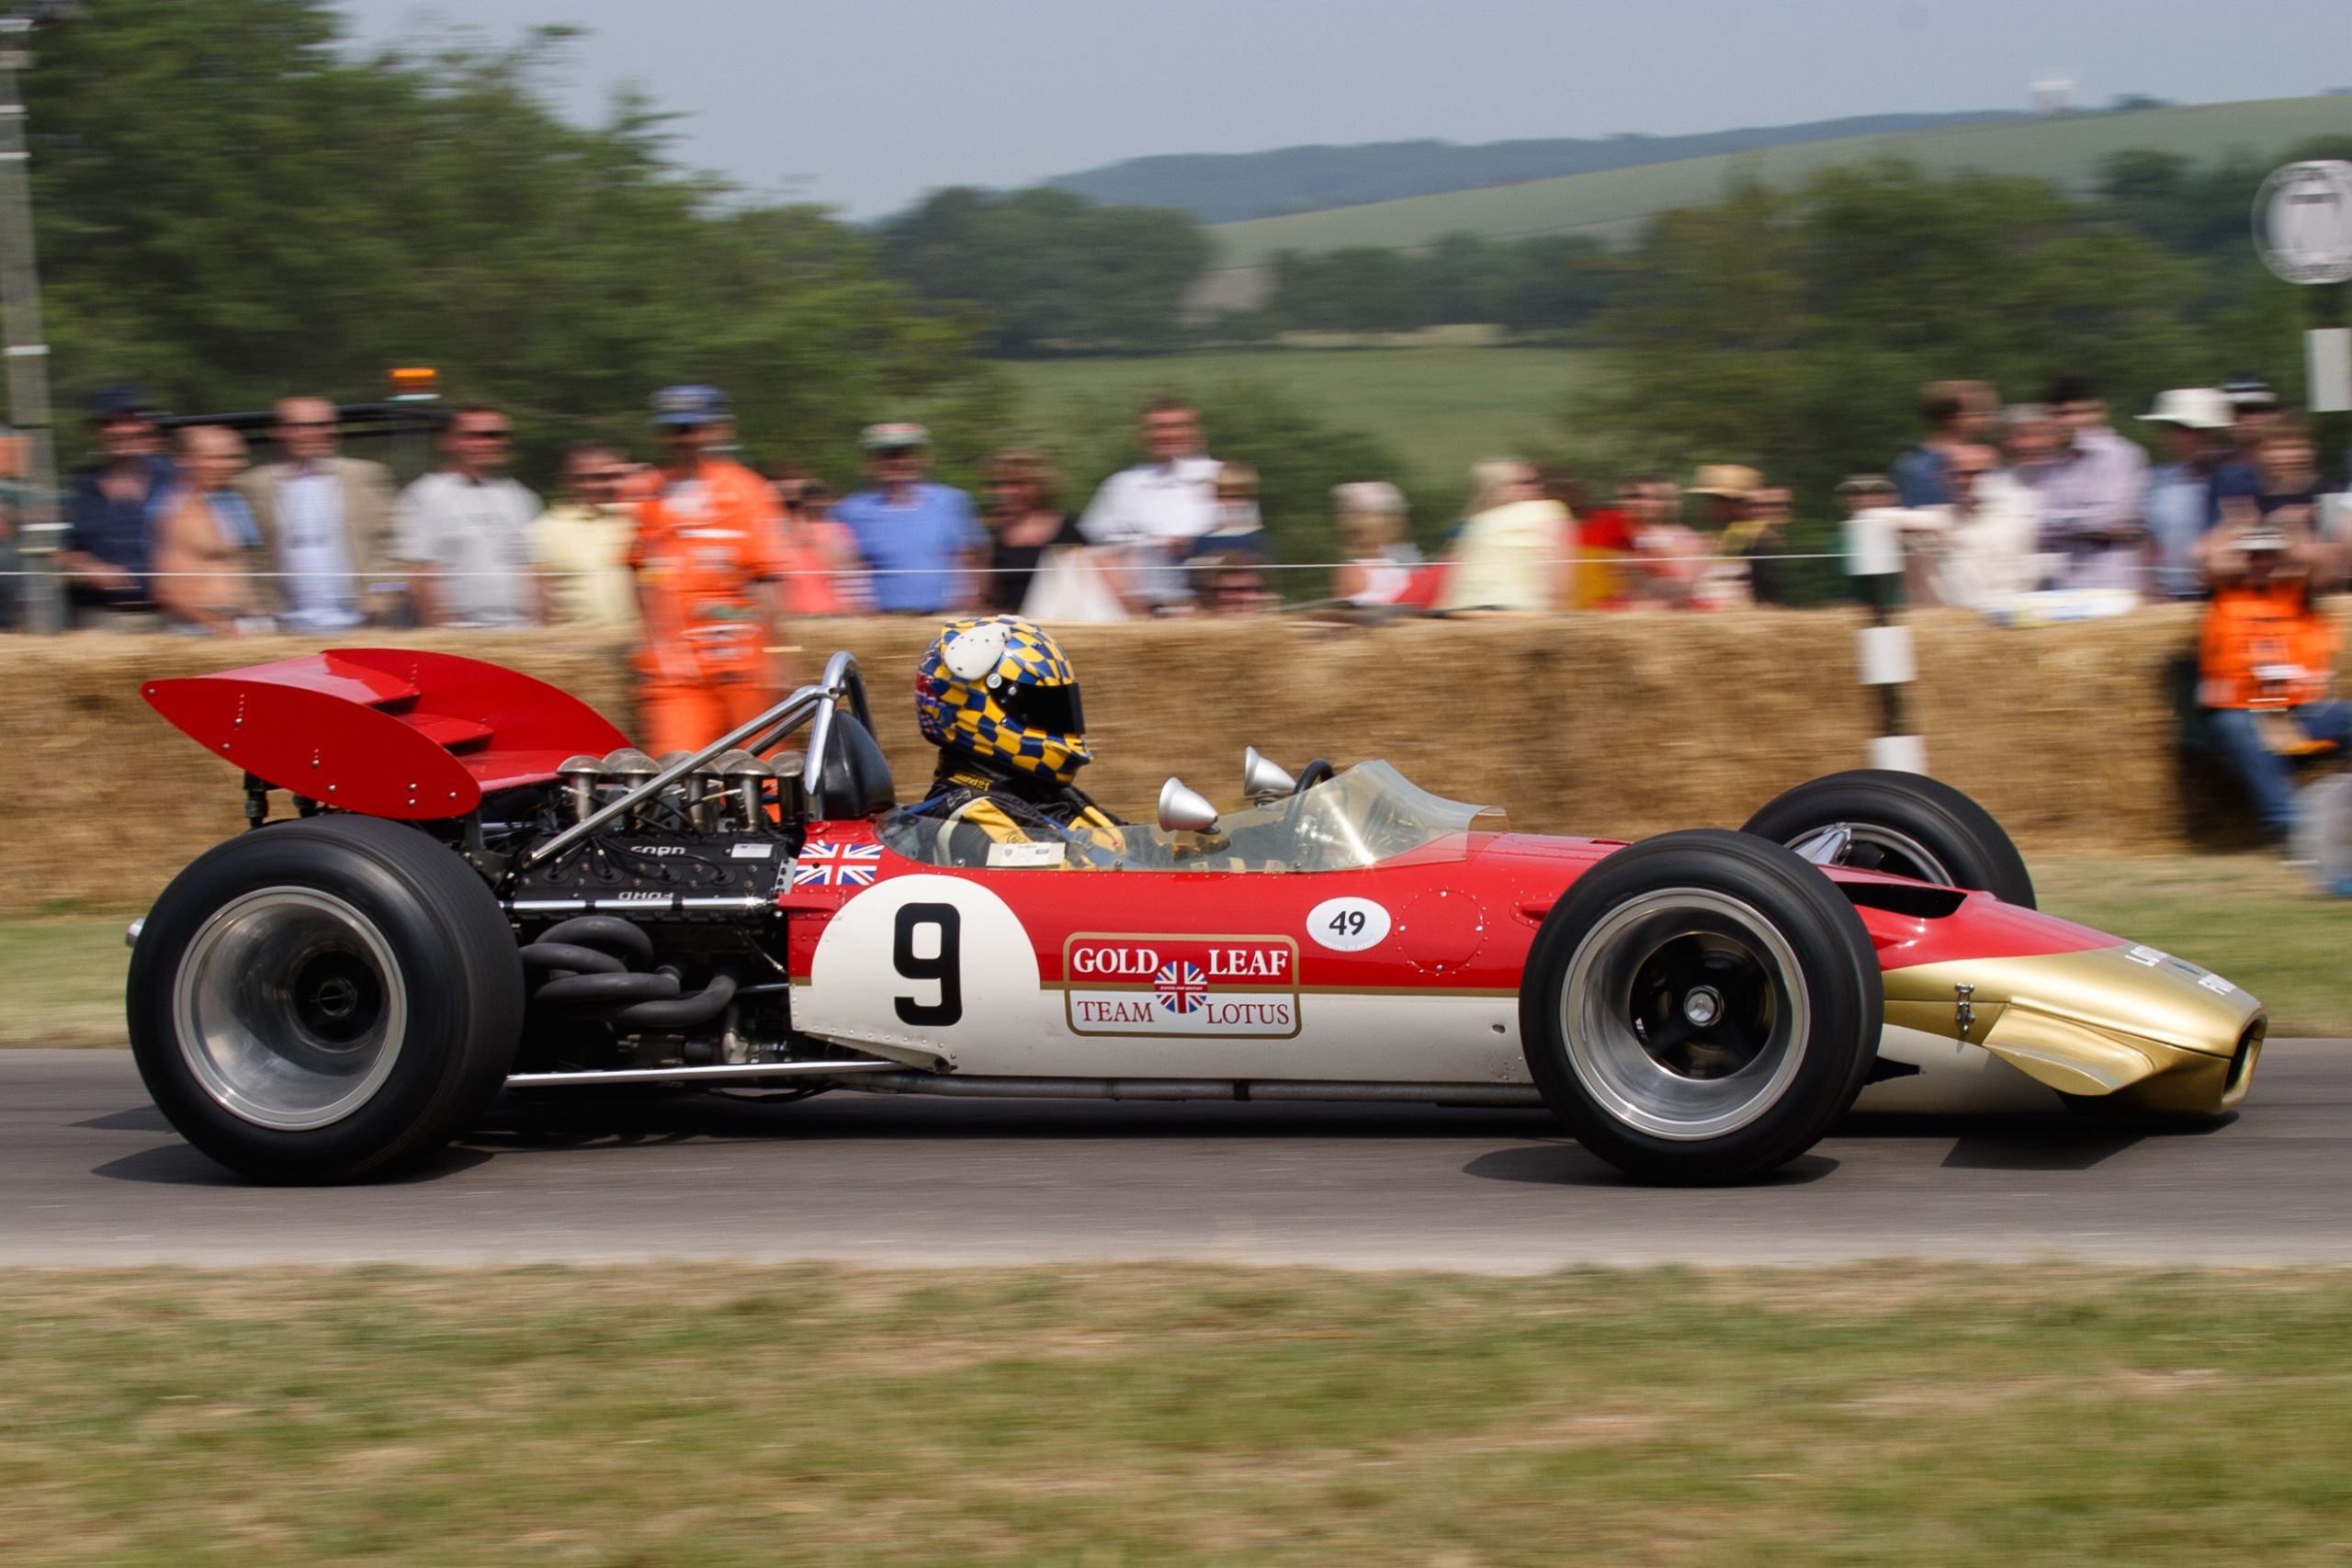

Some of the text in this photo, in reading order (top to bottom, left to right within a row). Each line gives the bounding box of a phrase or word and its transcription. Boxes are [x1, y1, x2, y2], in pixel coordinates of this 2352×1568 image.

[1329, 910, 1365, 936] 49
[893, 902, 963, 1027] 9
[1073, 947, 1288, 976] GOLD LEAF
[1077, 1001, 1290, 1025] TEAM LOTUS
